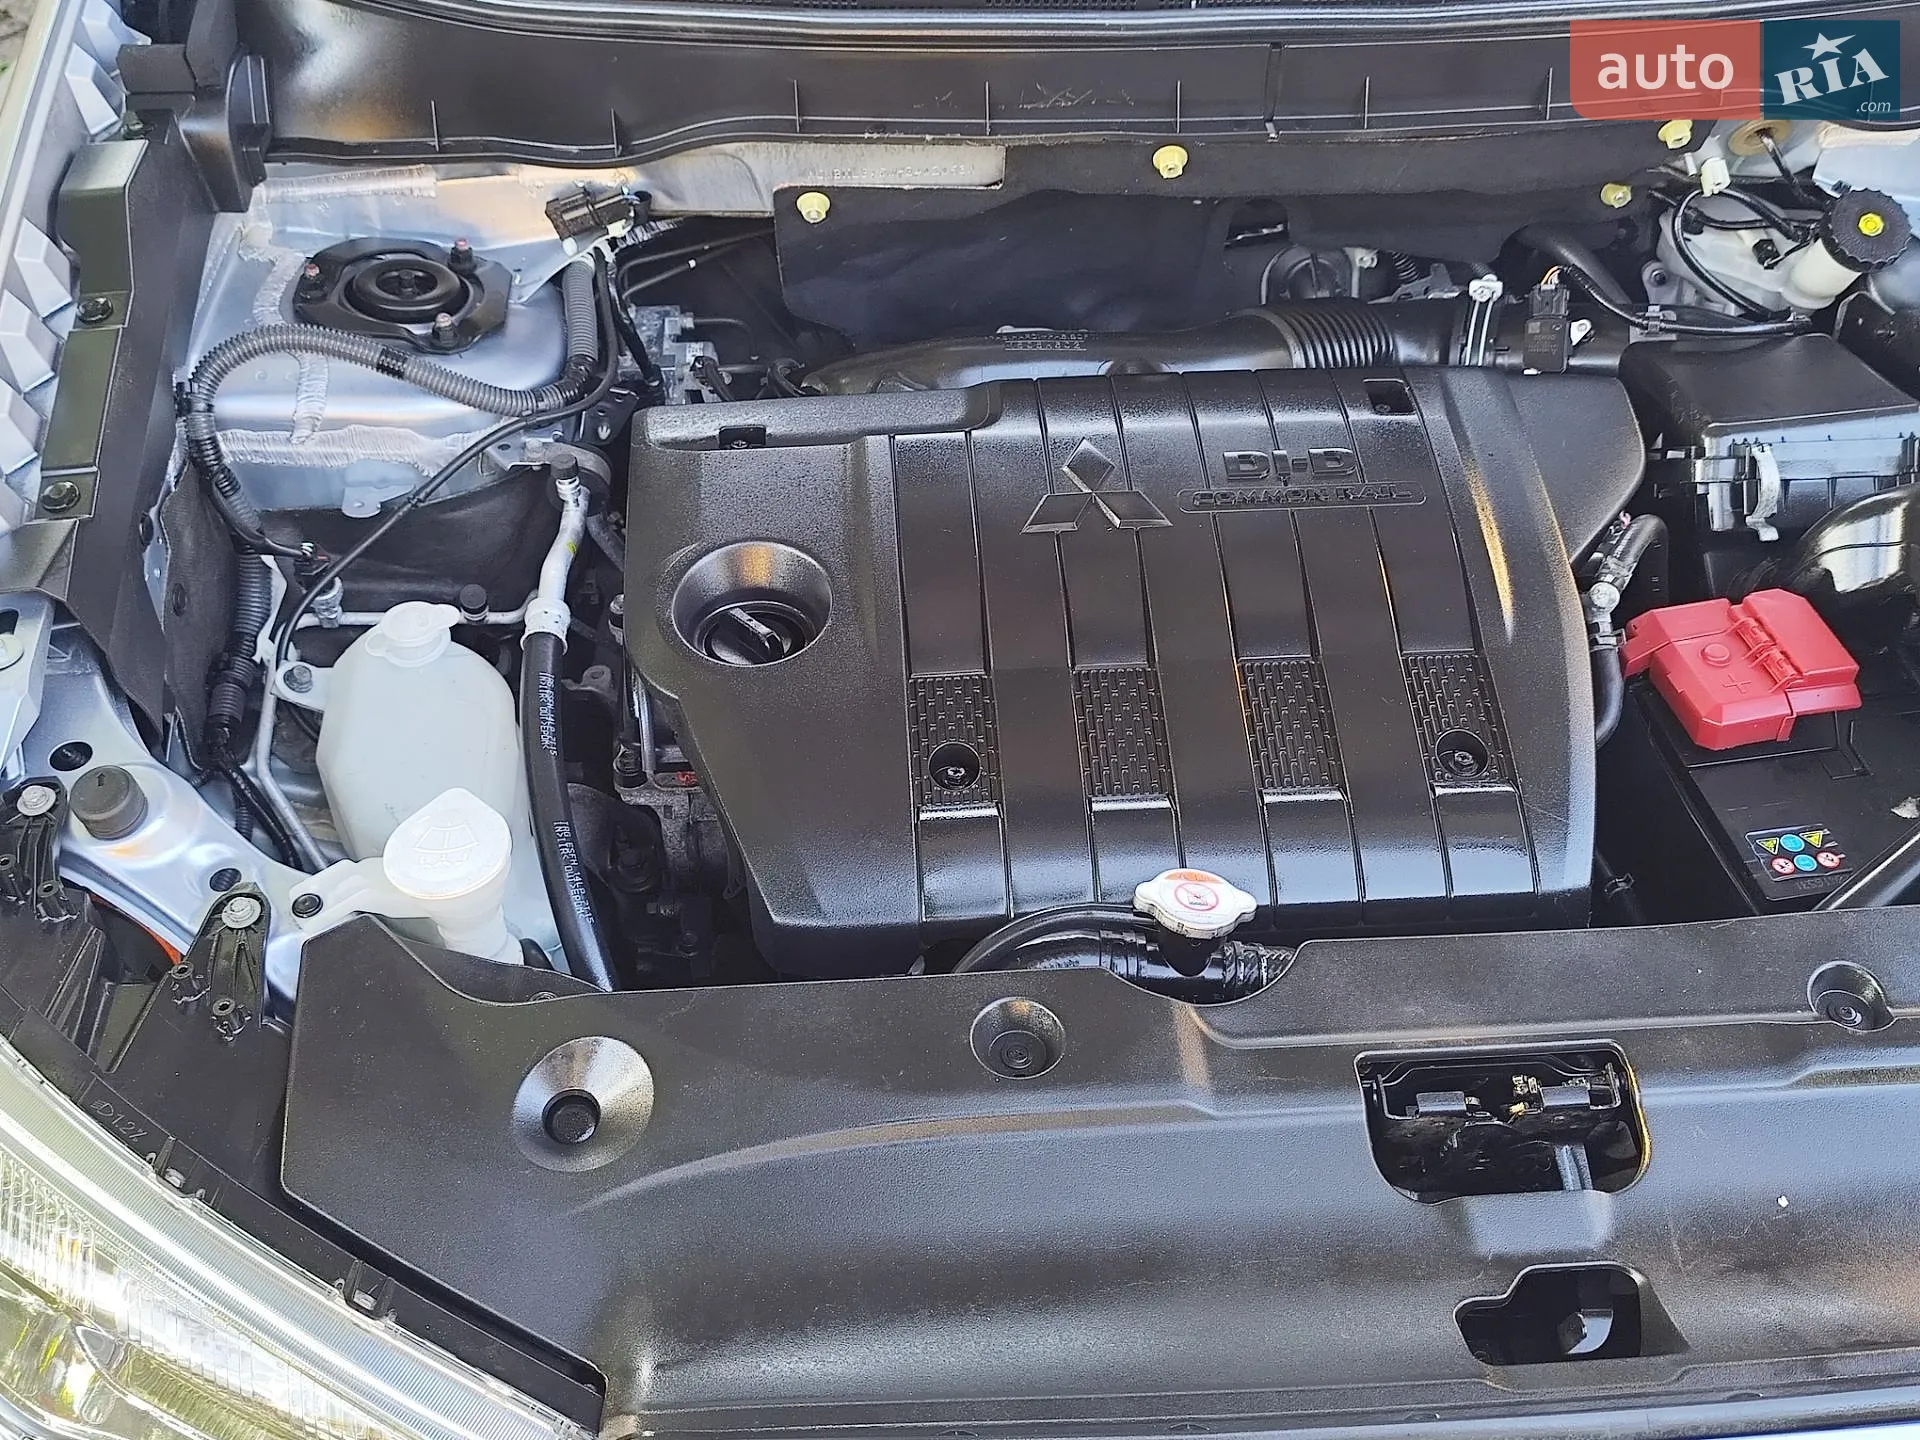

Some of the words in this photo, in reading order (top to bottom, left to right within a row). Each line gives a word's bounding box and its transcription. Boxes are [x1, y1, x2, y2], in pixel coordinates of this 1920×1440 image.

[1223, 447, 1357, 480] DI-D
[1193, 487, 1330, 506] COMMON
[1336, 484, 1412, 501] RAIL
